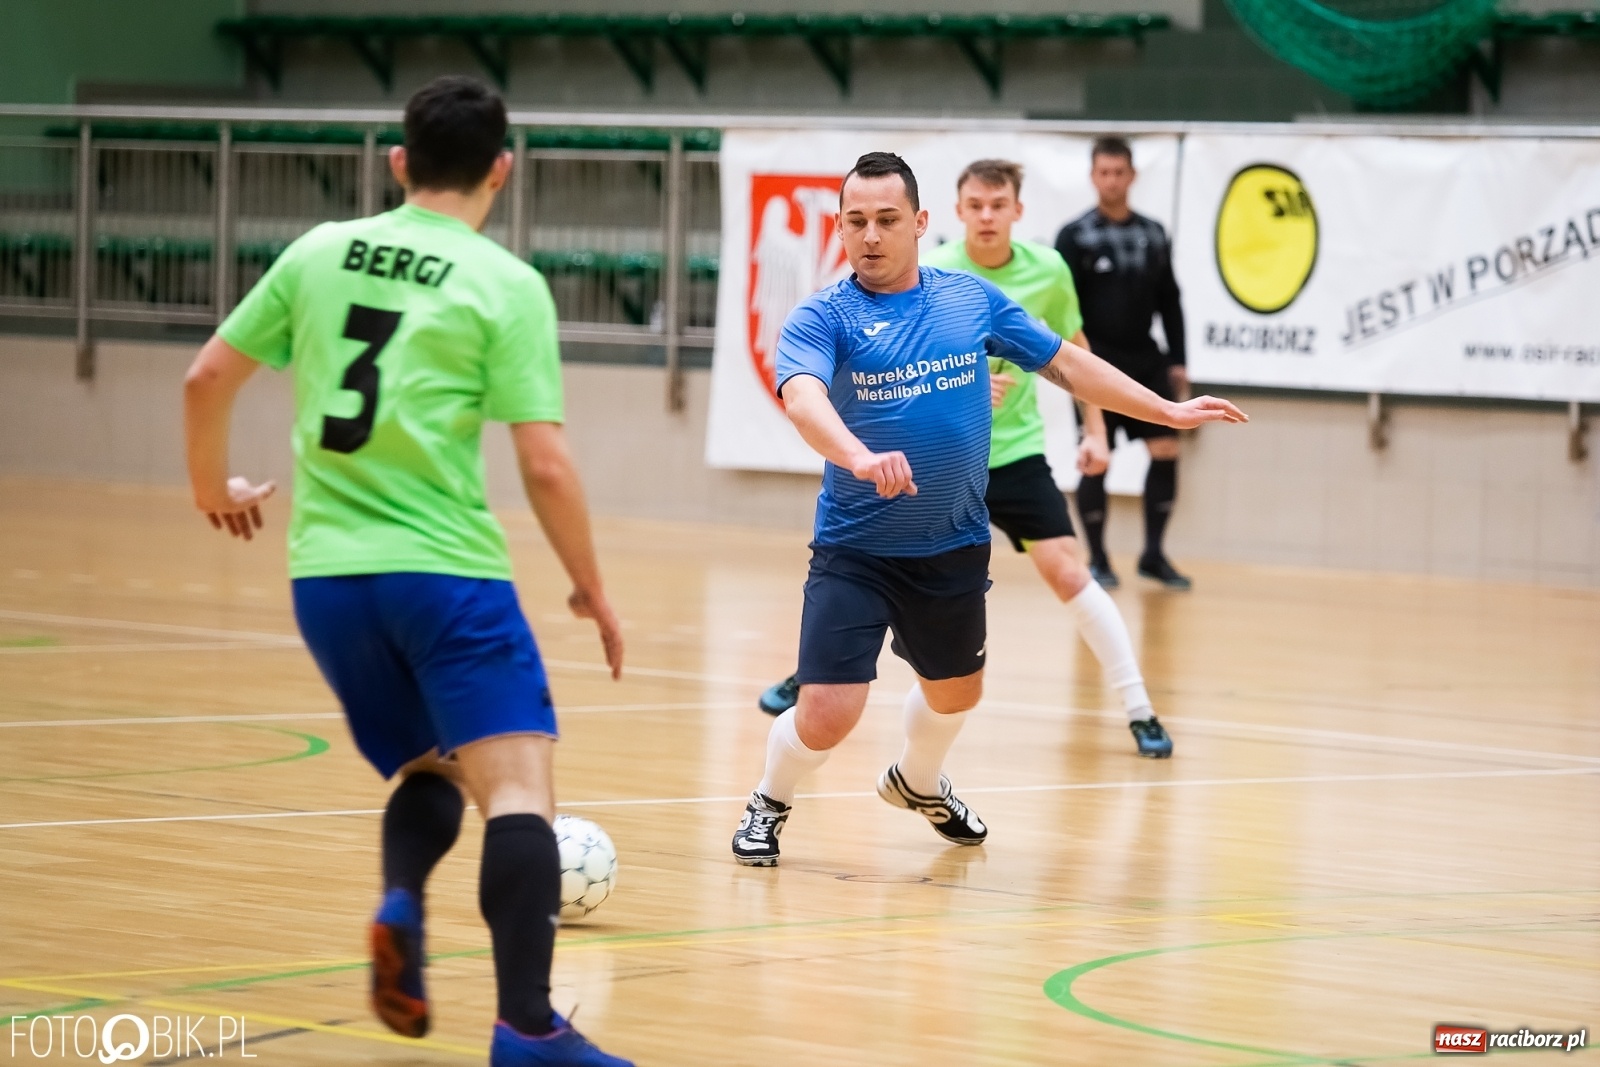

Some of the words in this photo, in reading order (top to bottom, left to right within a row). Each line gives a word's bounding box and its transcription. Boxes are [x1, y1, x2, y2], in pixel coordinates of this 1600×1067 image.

[342, 239, 454, 288] BERGI
[1339, 281, 1416, 345] JEST
[1428, 264, 1454, 304] W
[320, 303, 403, 454] 3
[851, 351, 977, 386] Marek&Dariusz
[856, 383, 931, 401] Metallbau
[936, 369, 975, 391] GmbH
